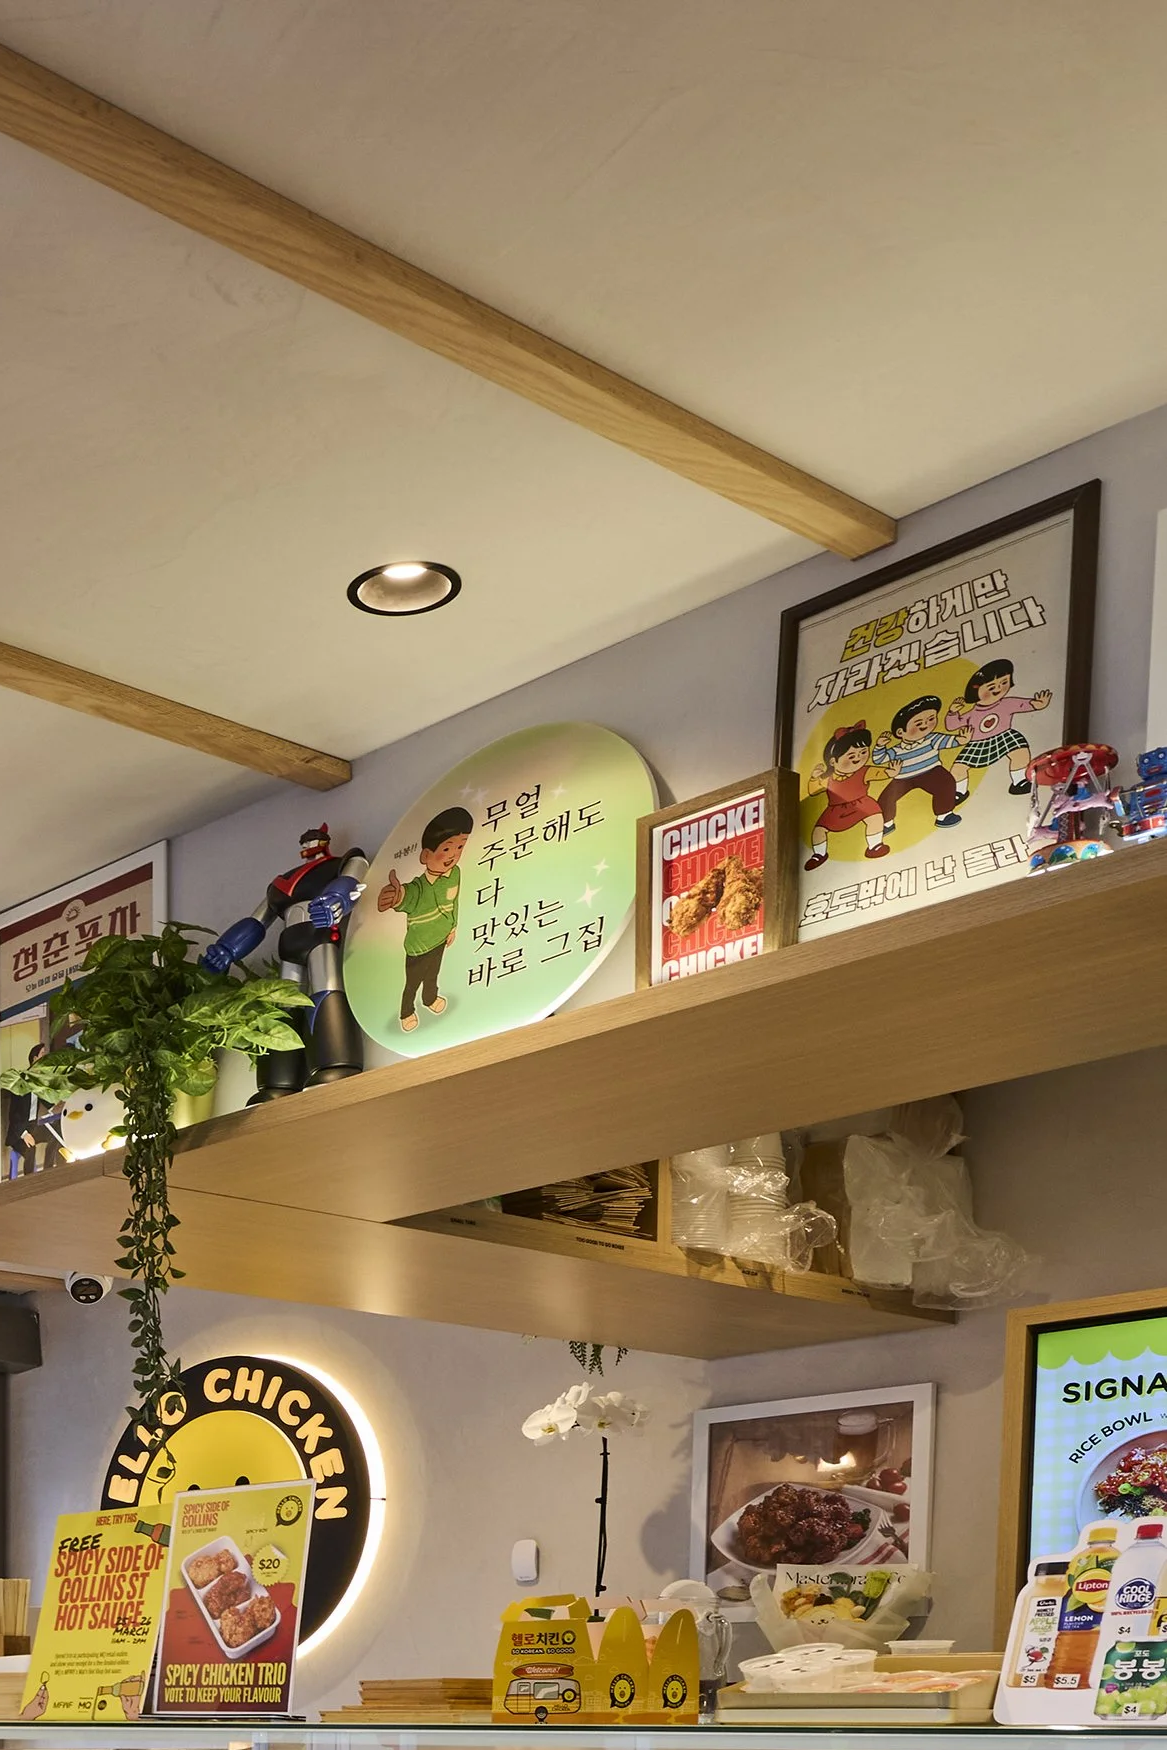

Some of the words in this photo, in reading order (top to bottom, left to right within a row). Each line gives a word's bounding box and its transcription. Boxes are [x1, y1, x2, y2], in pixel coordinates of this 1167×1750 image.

[840, 569, 1010, 663] 건강하게만
[807, 596, 1046, 713] 자라겠습니다
[481, 784, 542, 833] 무얼
[477, 801, 605, 871] 주문해도
[798, 866, 917, 928] 효도밖에
[925, 855, 957, 891] 난
[962, 834, 1032, 879] 몰라
[476, 877, 505, 908] 다
[472, 899, 565, 953] 맛있는
[468, 948, 528, 988] 바로
[1062, 1372, 1167, 1403] SIGNA
[108, 1391, 187, 1504] ELLO
[203, 1367, 348, 1520] CHICKEN
[1069, 1433, 1102, 1464] RICE
[1100, 1412, 1153, 1437] BOWL
[183, 1503, 205, 1514] SPICY
[205, 1501, 221, 1513] SIDE
[221, 1500, 230, 1511] OF
[112, 1514, 123, 1525] TRY
[123, 1513, 138, 1524] THIS
[182, 1512, 218, 1528] COLLINS
[58, 1533, 103, 1554] FREE
[54, 1548, 105, 1578] SPICY
[105, 1545, 144, 1574] SIDE
[144, 1543, 165, 1571] OF
[258, 1558, 281, 1570] $20
[58, 1574, 126, 1604] COLLINS
[127, 1572, 150, 1600] ST
[1078, 1582, 1109, 1591] Lipton
[1123, 1586, 1151, 1594] COOL
[1119, 1594, 1152, 1603] RIDGE
[54, 1604, 89, 1631] HOT
[88, 1600, 145, 1630] SAUCE
[140, 1616, 152, 1626] 26
[113, 1626, 150, 1636] MARCH
[511, 1632, 560, 1647] 헬로치킨
[1118, 1626, 1131, 1635] $4
[164, 1663, 200, 1687] SPICY
[201, 1663, 255, 1686] CHICKEN
[257, 1662, 287, 1685] TRIO
[1023, 1675, 1035, 1684] $5
[1111, 1658, 1166, 1680] 봉봉
[1054, 1676, 1077, 1685] $5.5
[164, 1687, 183, 1703] VOTE
[186, 1687, 195, 1703] TO
[196, 1687, 218, 1703] KEEP
[219, 1687, 242, 1703] YOUR
[242, 1687, 282, 1703] FLAVOUR
